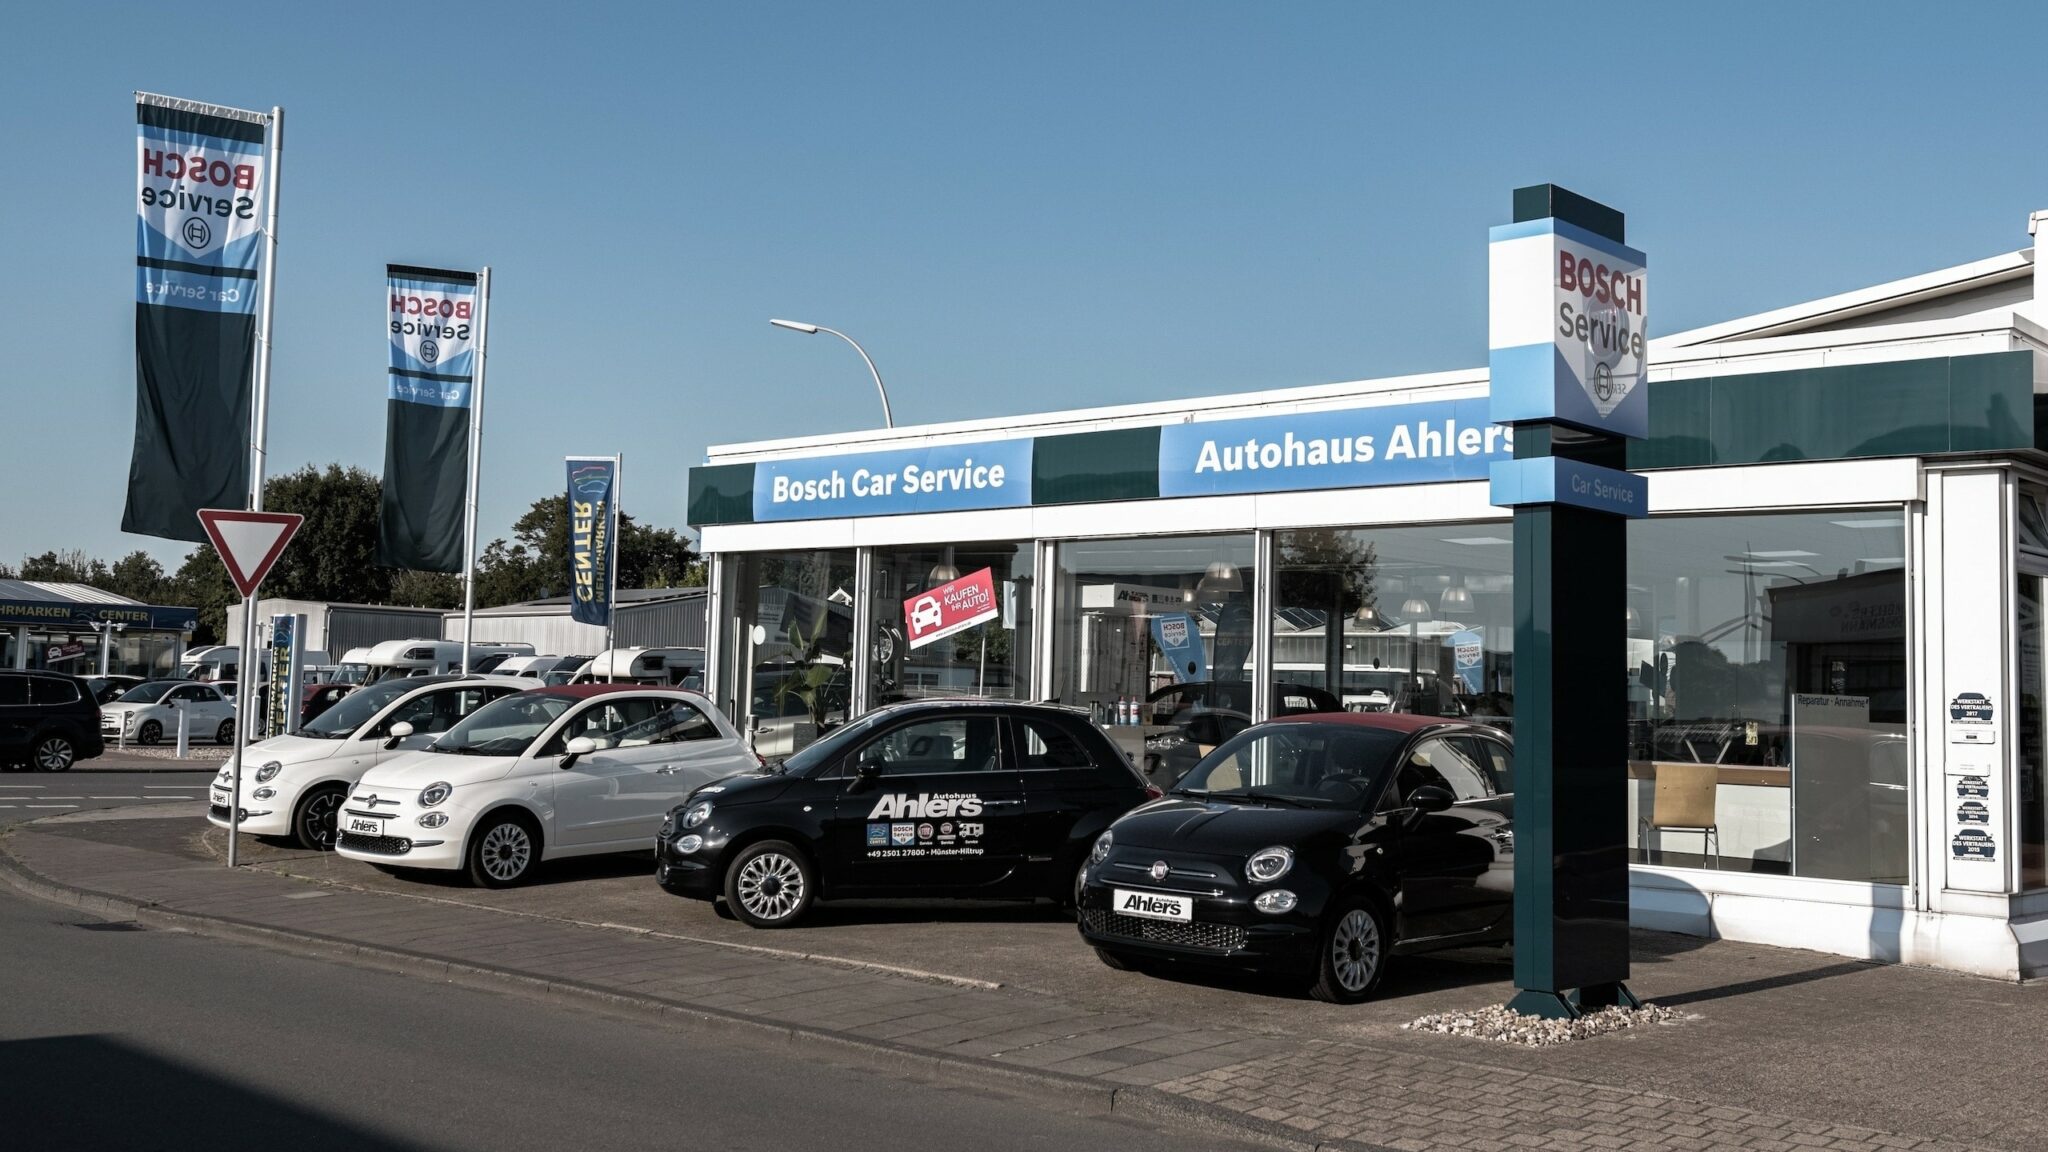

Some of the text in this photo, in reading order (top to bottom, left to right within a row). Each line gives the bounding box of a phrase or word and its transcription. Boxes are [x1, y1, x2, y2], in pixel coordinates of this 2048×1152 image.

[1560, 249, 1642, 316] BOSCH
[1559, 302, 1643, 360] Service
[1195, 431, 1376, 473] Autohaus
[773, 458, 1006, 503] Bosch Car Service
[1571, 473, 1633, 504] Car Service
[944, 584, 979, 606] KAUFEN
[962, 588, 989, 610] AUTO!
[99, 609, 148, 621] CENTER
[183, 620, 197, 630] 43
[1798, 694, 1830, 707] Reparatur
[867, 793, 983, 819] Ahlers
[350, 819, 378, 832] Ahlers
[867, 850, 881, 858] +49
[882, 849, 900, 857] 2501
[902, 849, 925, 857] 27800
[930, 846, 984, 856] Münster-Hiltrup
[1122, 894, 1182, 916] Ahlers
